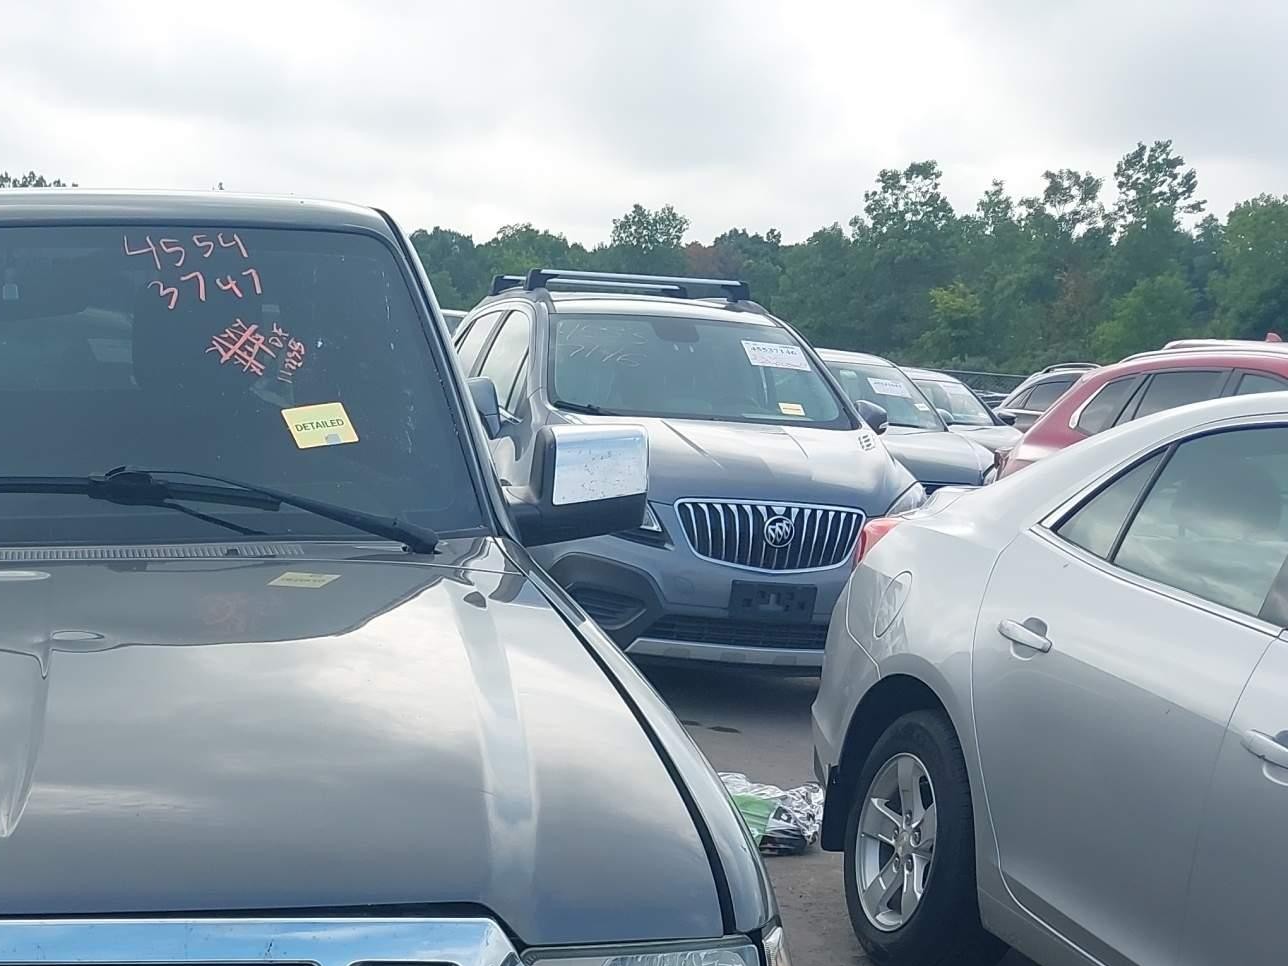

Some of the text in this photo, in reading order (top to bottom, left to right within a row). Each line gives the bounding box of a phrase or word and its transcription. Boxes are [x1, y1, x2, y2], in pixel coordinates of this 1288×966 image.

[123, 232, 249, 270] 4554
[147, 268, 263, 310] 3747
[294, 417, 345, 433] DETAILED
